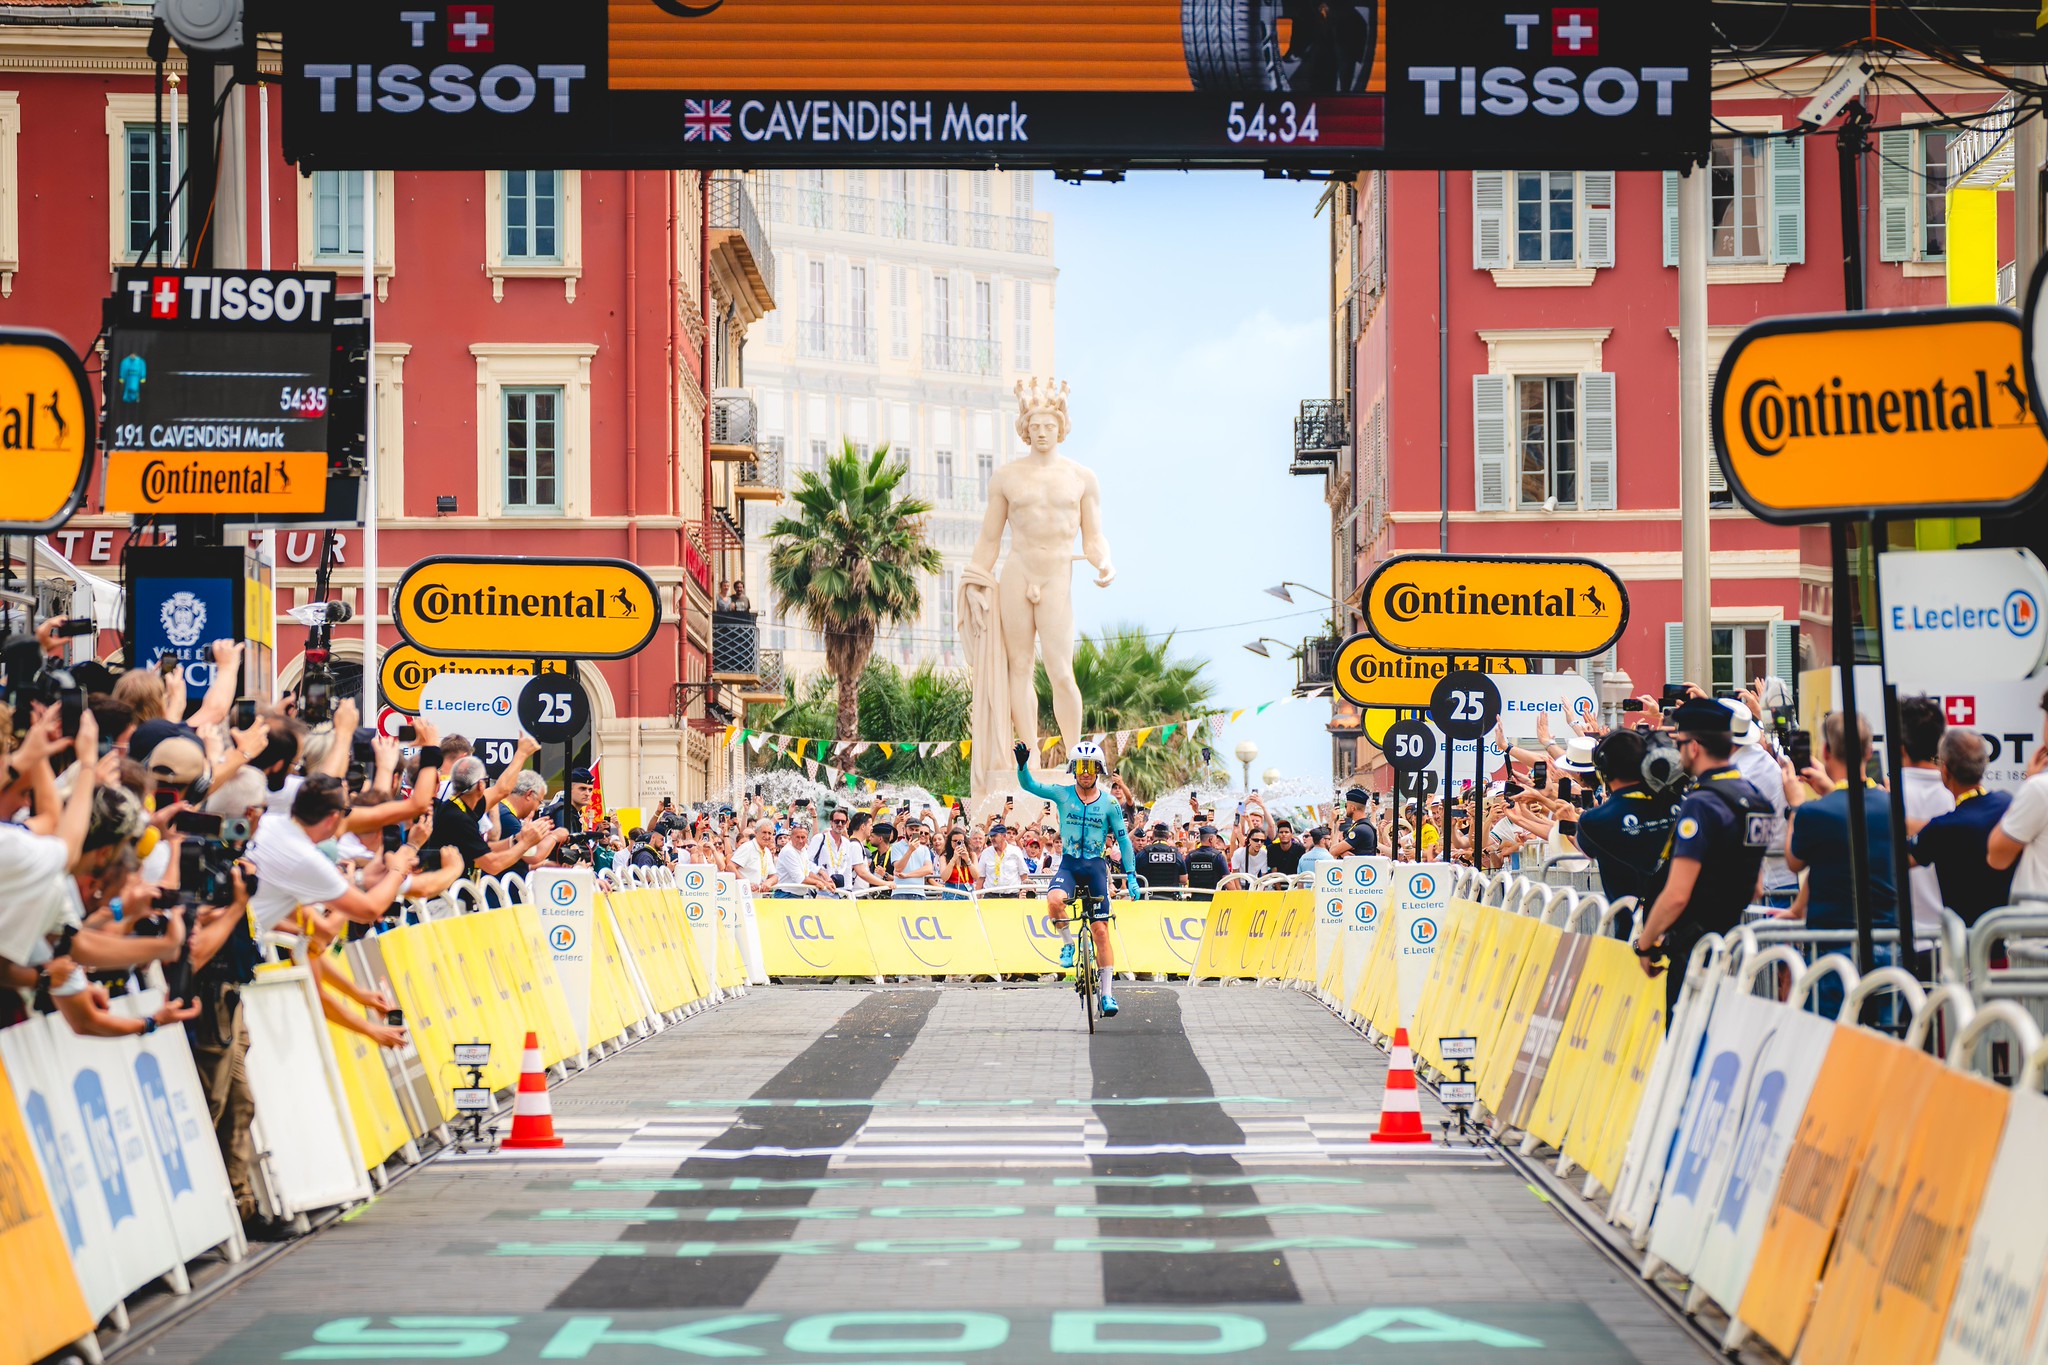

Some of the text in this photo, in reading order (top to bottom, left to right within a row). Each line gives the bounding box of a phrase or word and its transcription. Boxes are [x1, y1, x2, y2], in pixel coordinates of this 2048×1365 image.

[400, 11, 436, 47] T
[1504, 14, 1540, 50] T
[304, 64, 586, 113] TISSOT
[1408, 66, 1689, 116] TISSOT
[739, 100, 1320, 143] CAVENDISH Mark 54:34
[127, 276, 332, 322] T TISSOT
[280, 387, 328, 411] 54:35
[1741, 369, 1994, 457] Continental
[115, 424, 286, 449] 191 CAVENDISH Mark
[141, 460, 271, 504] Continental
[413, 583, 607, 624] Continental
[1384, 582, 1576, 623] Continental
[1892, 604, 2000, 631] E.Leclerc
[425, 699, 490, 712] E.Leclerc
[538, 693, 573, 724] 25
[1450, 691, 1485, 721] 25
[1507, 700, 1564, 713] E.Lecler
[485, 742, 514, 765] 50
[1395, 734, 1424, 757] 50
[1408, 772, 1429, 791] 75
[1151, 853, 1174, 863] CRS
[541, 908, 585, 917] E.Leclerc
[1402, 902, 1444, 910] E.Leclerc
[786, 915, 835, 940] LCL
[901, 916, 953, 941] LCL
[553, 953, 584, 962] eclerc
